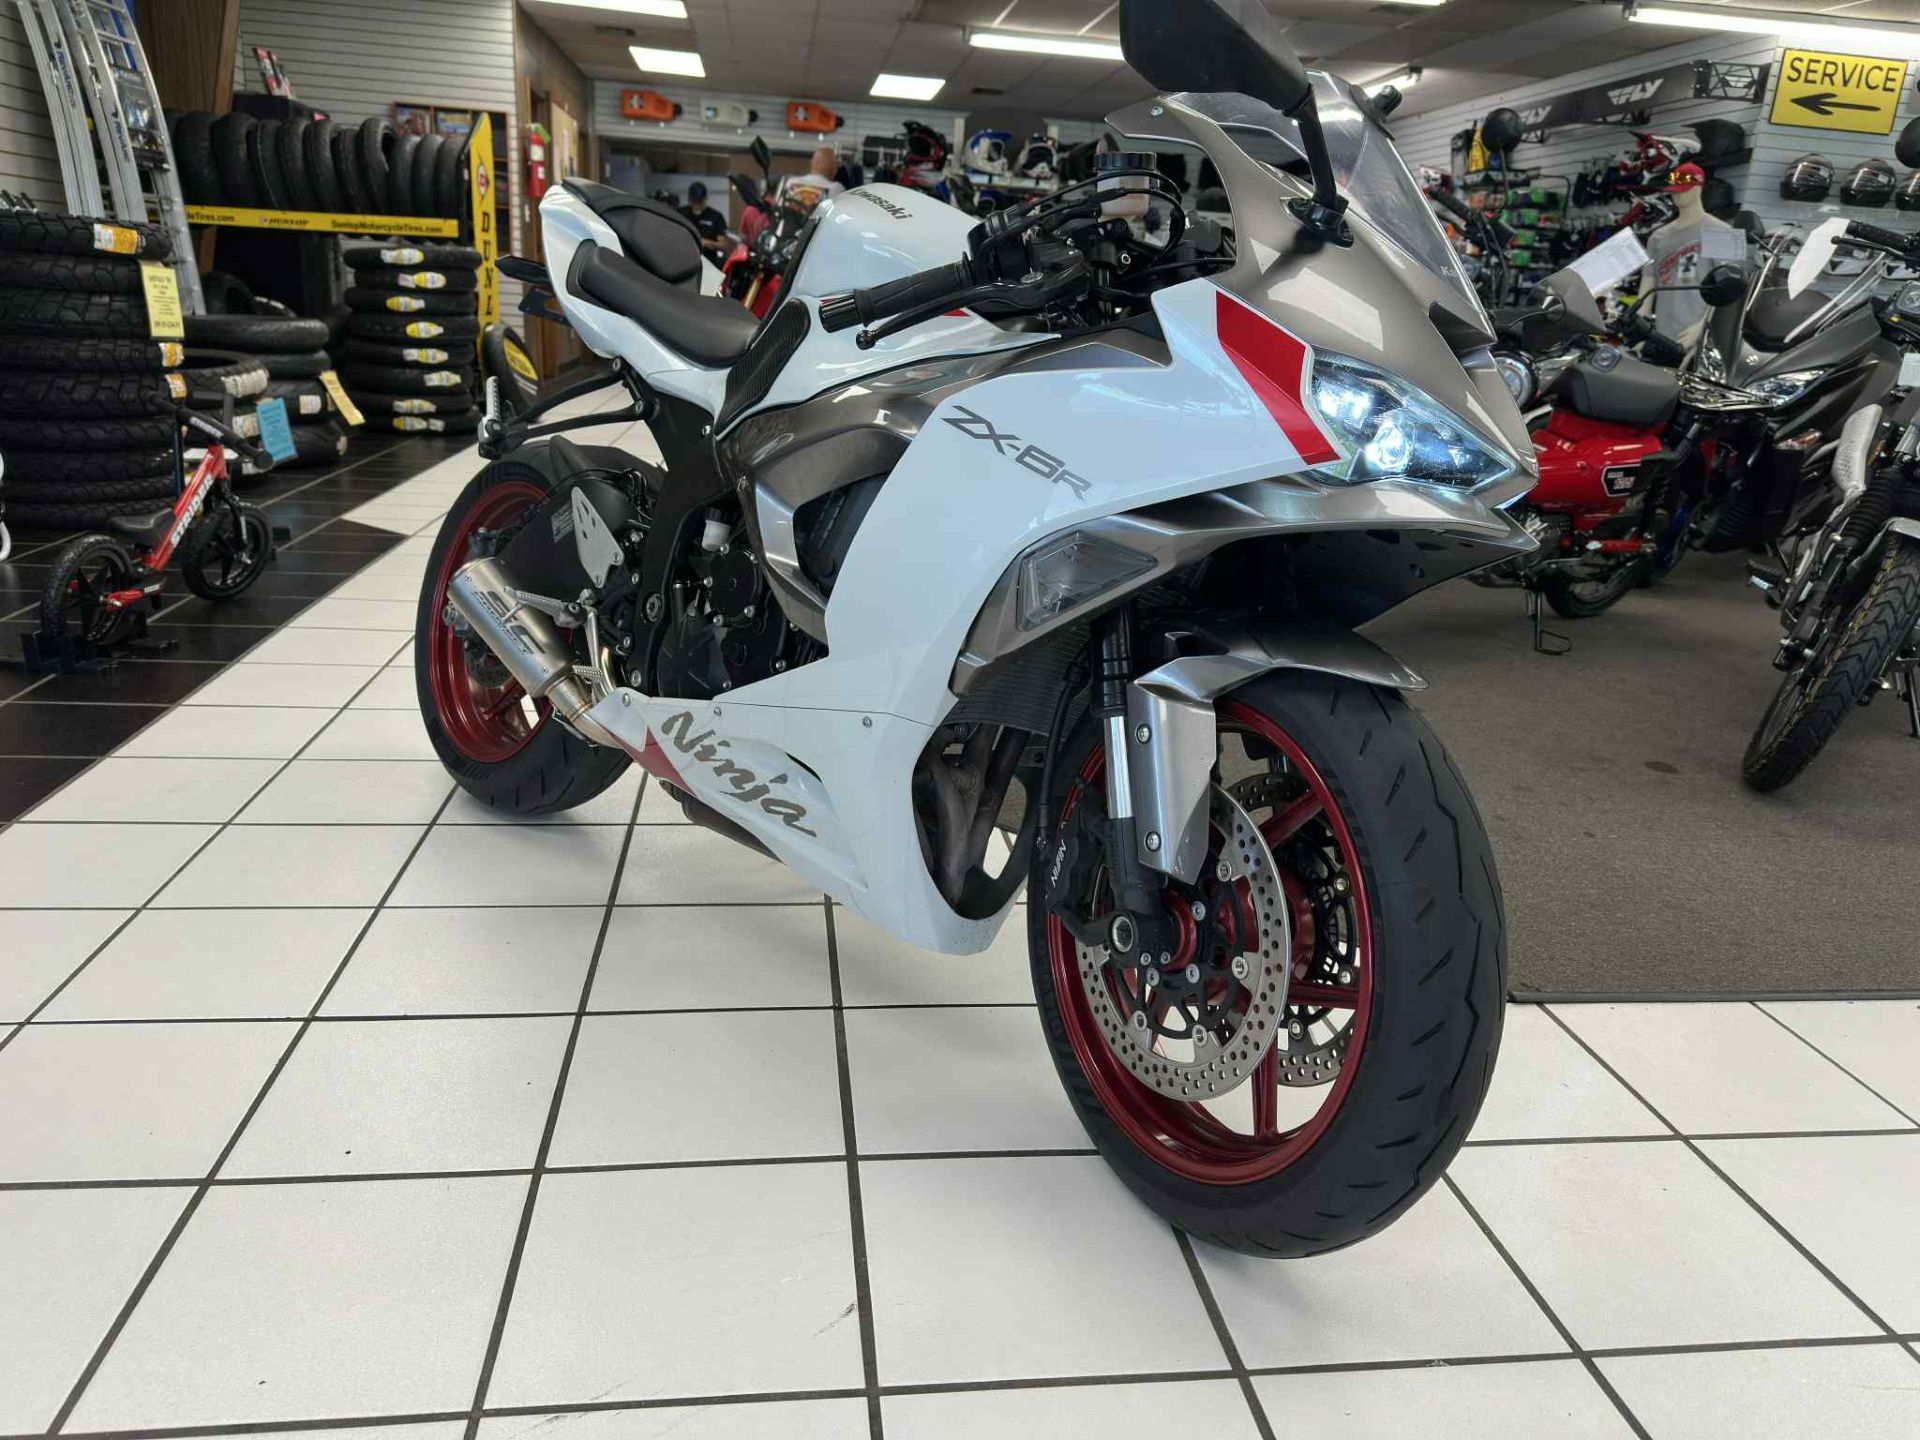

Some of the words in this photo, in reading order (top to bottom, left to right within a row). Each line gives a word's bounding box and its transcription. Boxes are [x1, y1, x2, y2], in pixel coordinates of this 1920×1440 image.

[1607, 78, 1664, 105] FLY
[1787, 57, 1900, 92] SERVICE
[481, 211, 494, 328] DUNL
[940, 405, 1092, 501] ZX-6R
[169, 472, 214, 548] STRIDER
[661, 710, 818, 838] Ninja
